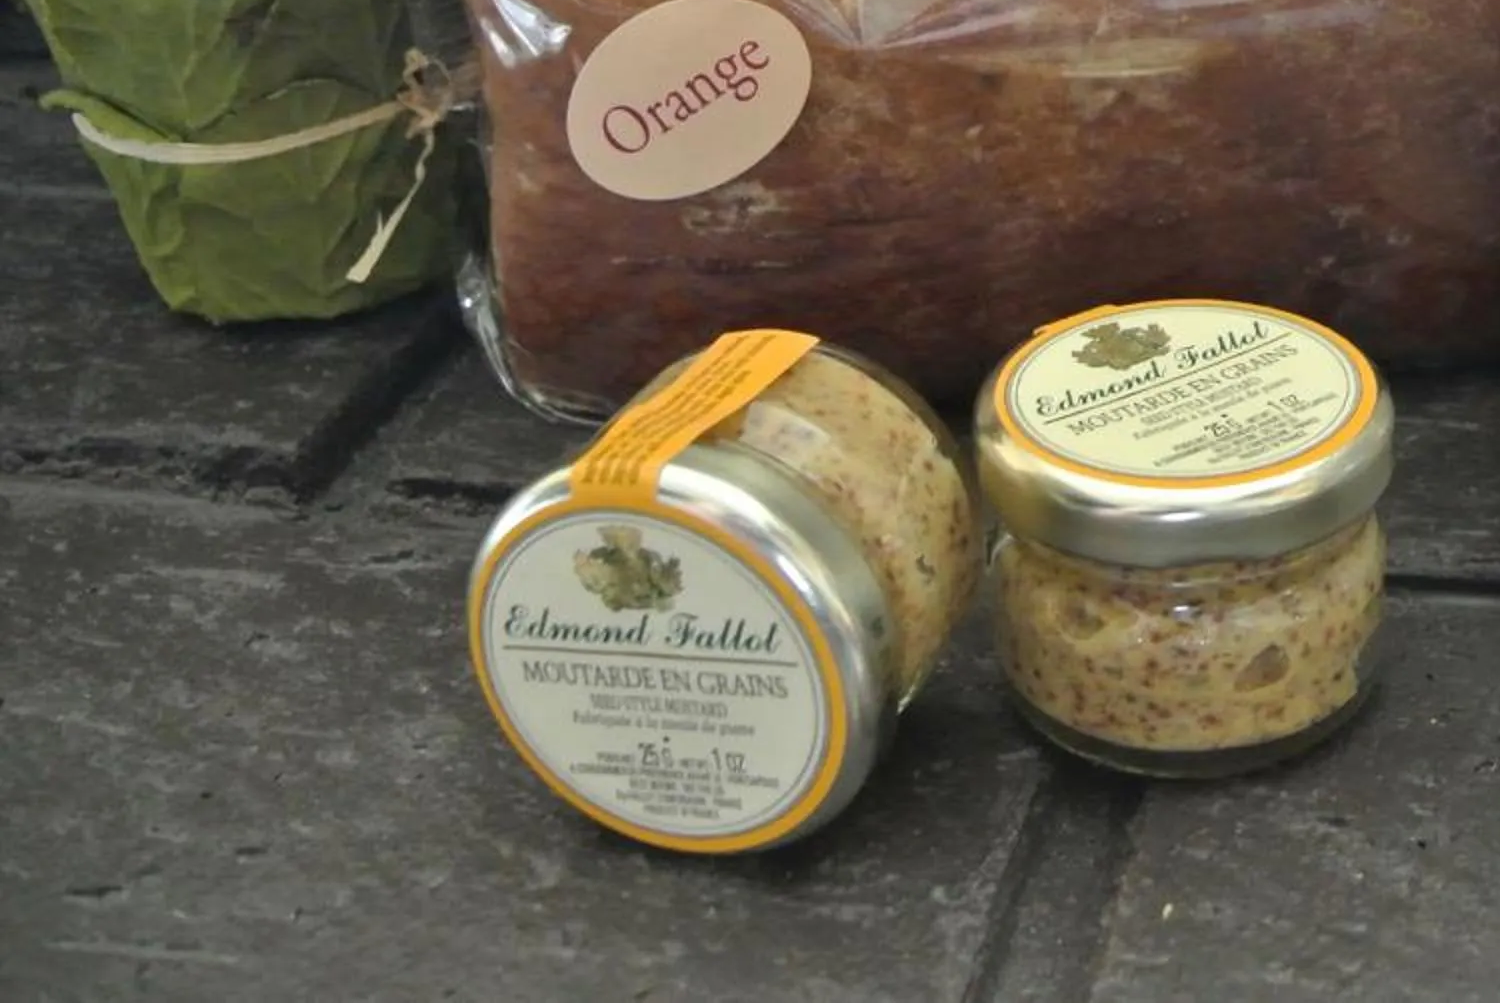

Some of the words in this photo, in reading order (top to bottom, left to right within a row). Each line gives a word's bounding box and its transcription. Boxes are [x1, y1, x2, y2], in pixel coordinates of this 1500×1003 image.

[602, 40, 770, 154] Orange
[1036, 360, 1168, 417] Edmond
[1173, 320, 1269, 370] Fallot
[1067, 383, 1189, 436] MOUTARDE
[1187, 372, 1221, 394] EN
[1220, 343, 1299, 380] GRAINS
[503, 603, 649, 646] Edmond
[664, 611, 782, 654] Fallot
[522, 660, 656, 691] MOUTARDE
[660, 668, 692, 694] EN
[696, 670, 789, 699] GRAINS
